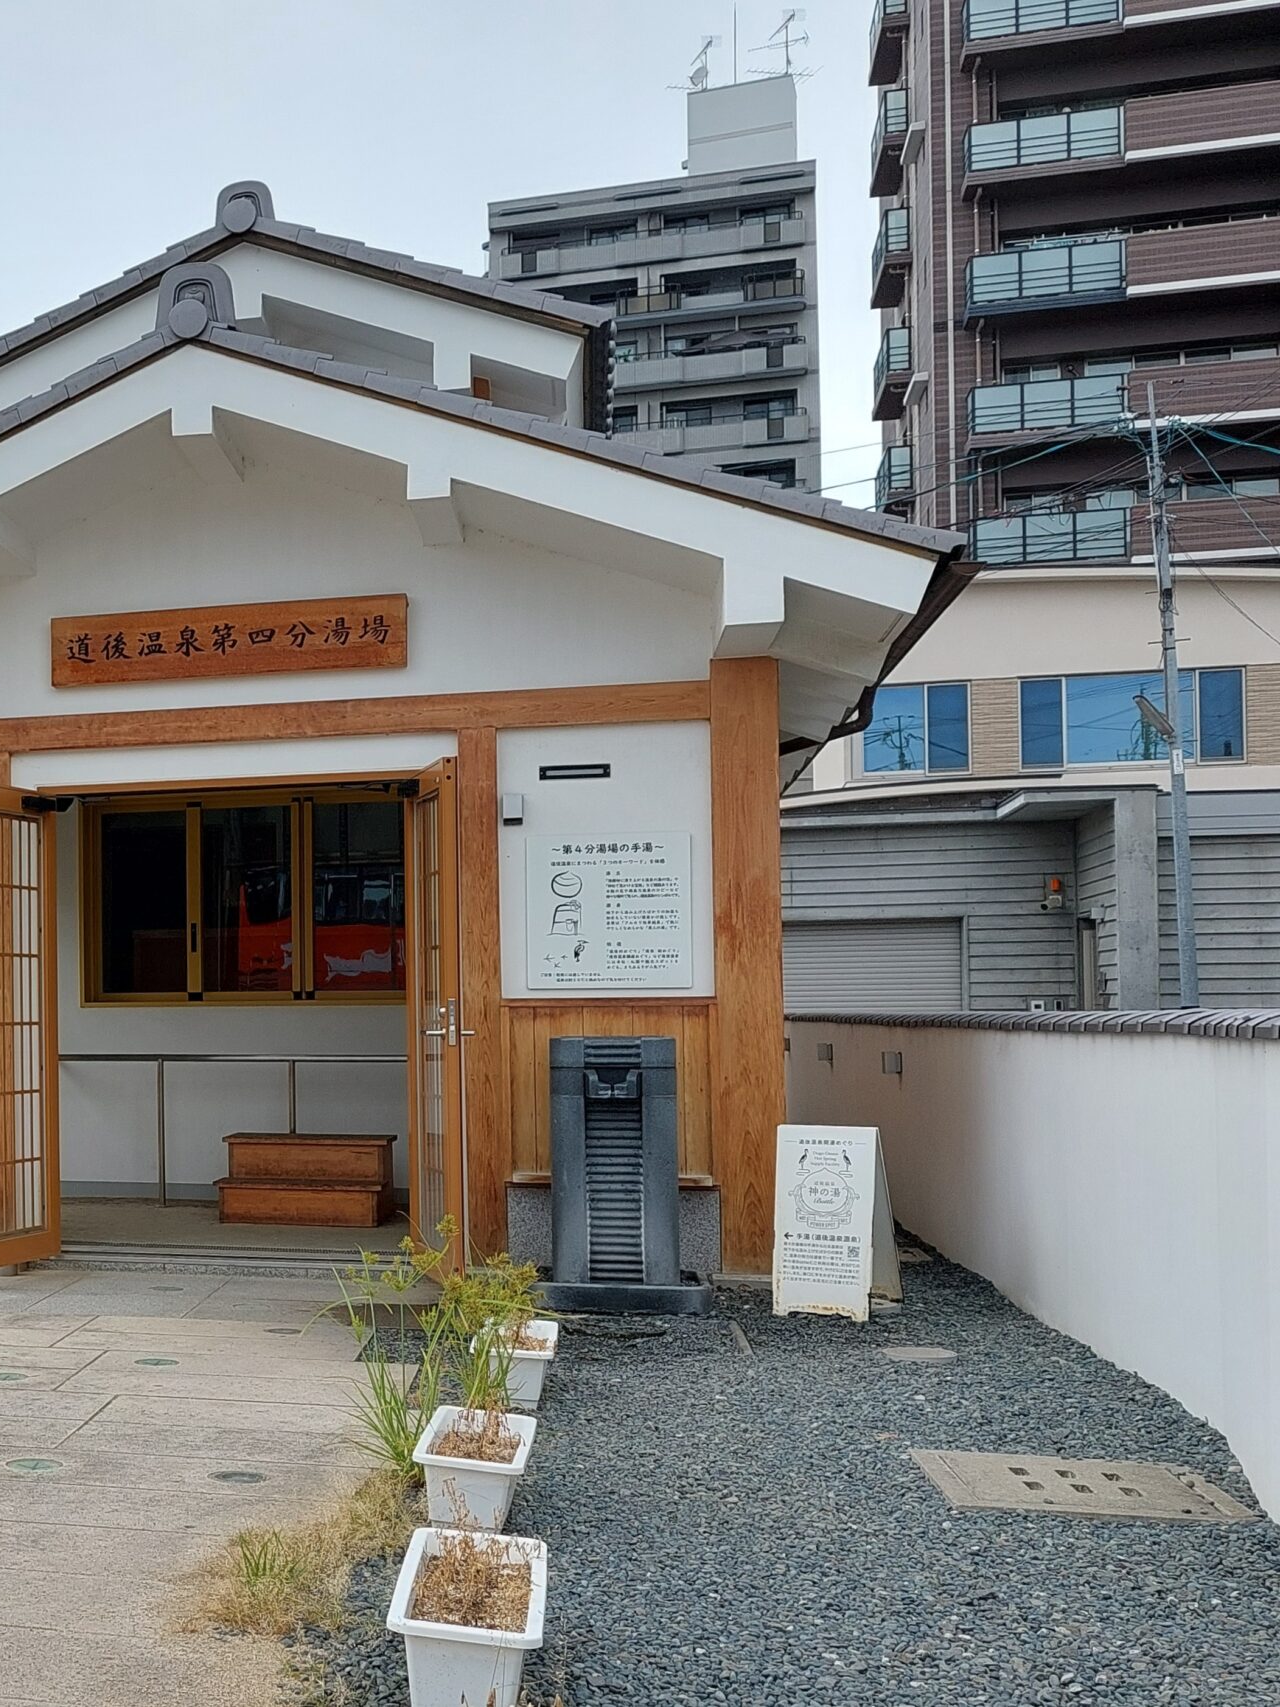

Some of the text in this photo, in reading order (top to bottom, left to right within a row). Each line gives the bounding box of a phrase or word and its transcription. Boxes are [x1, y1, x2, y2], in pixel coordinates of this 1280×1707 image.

[66, 614, 393, 665] 道後温泉第四分湯場
[808, 1186, 841, 1197] 神の湯
